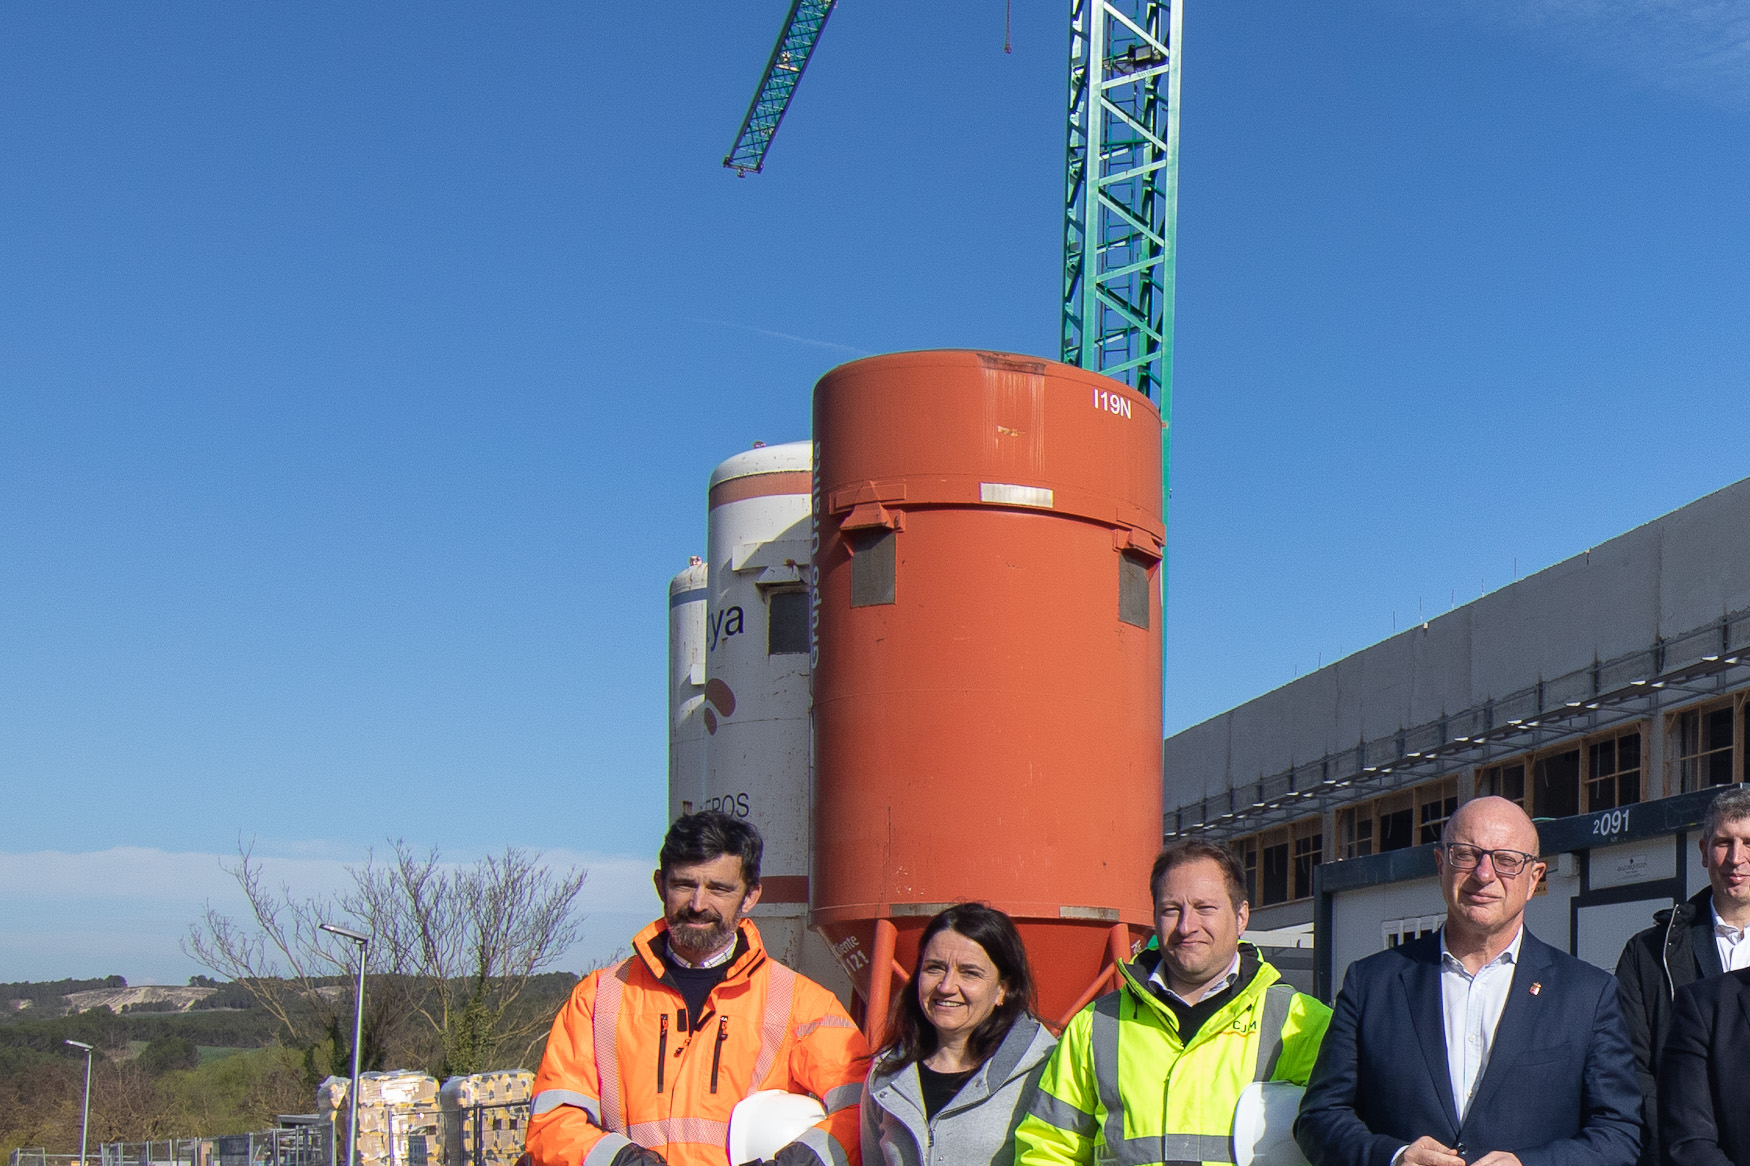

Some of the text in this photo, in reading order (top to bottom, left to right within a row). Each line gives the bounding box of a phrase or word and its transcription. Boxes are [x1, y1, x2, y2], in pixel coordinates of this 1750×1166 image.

[1093, 388, 1132, 420] I19N
[708, 605, 744, 652] ya
[811, 566, 823, 670] Grupo
[1592, 808, 1630, 836] 2091
